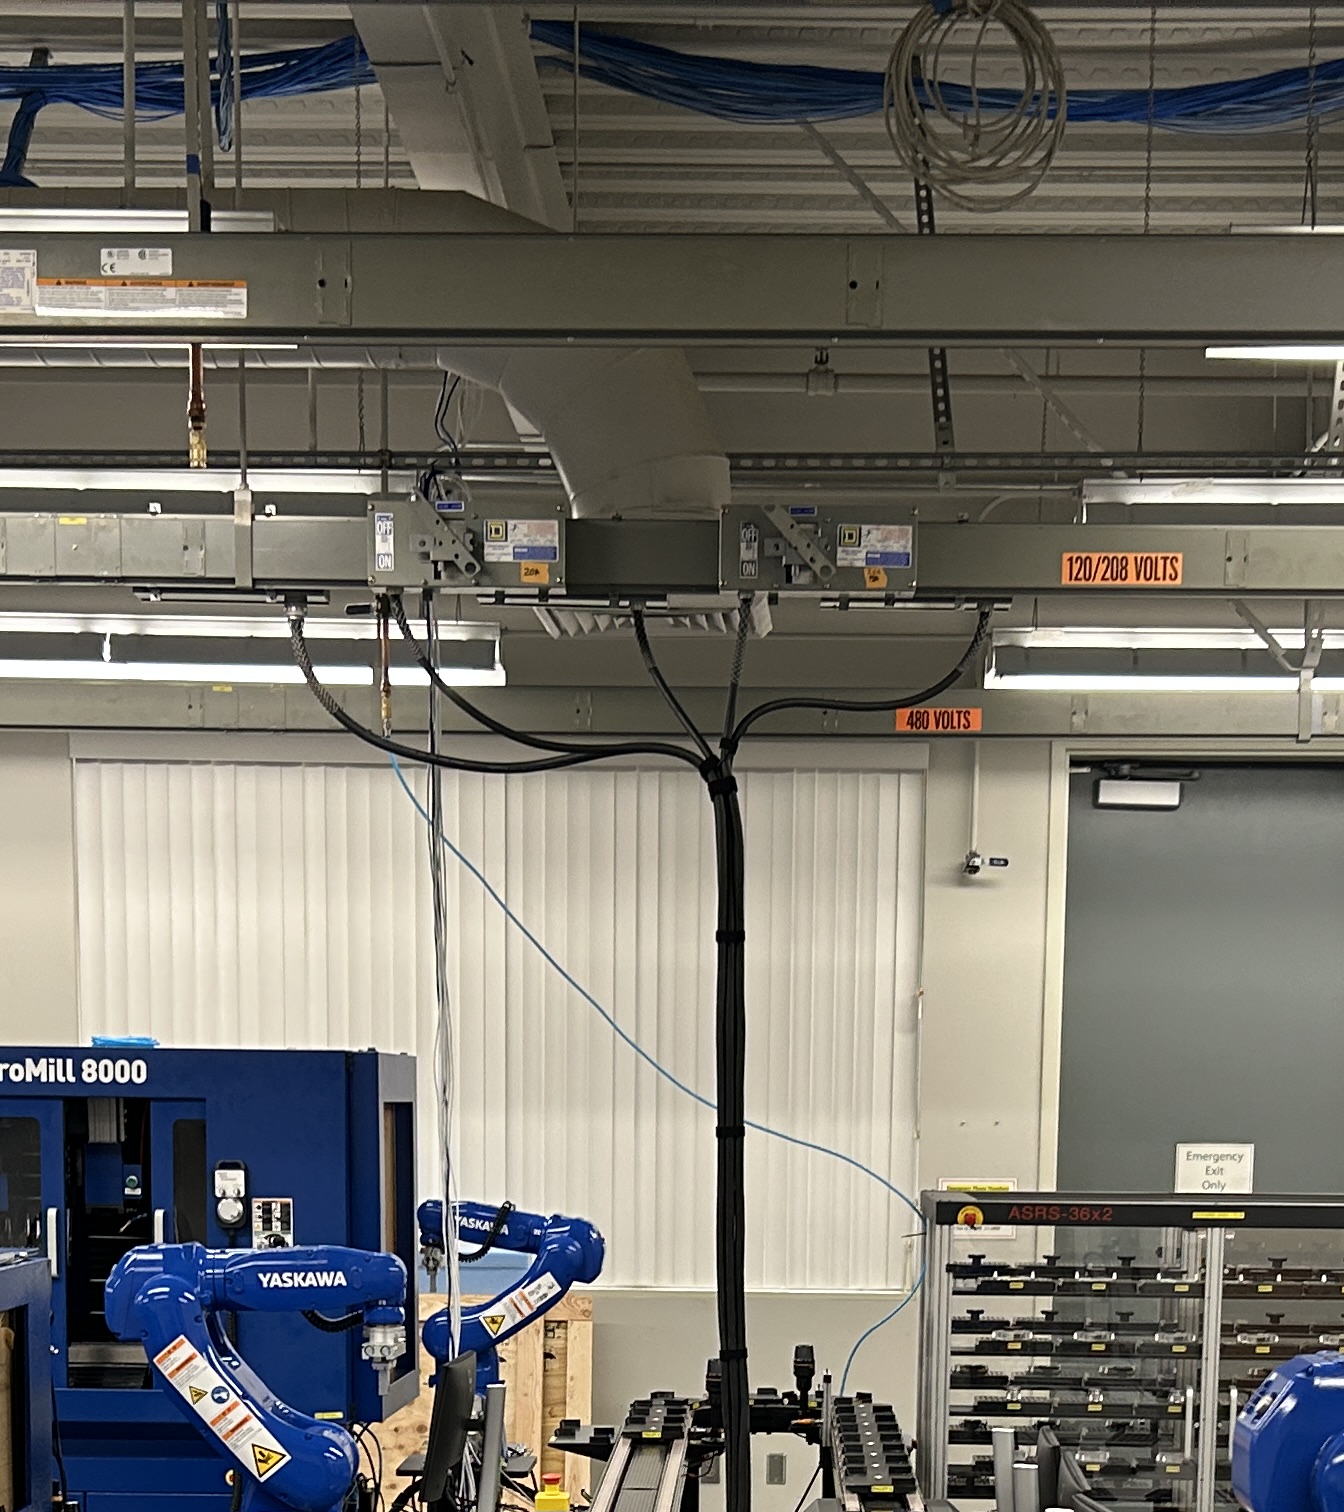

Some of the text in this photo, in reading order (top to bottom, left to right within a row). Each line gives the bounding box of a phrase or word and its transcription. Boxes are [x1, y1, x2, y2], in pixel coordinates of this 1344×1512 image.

[378, 555, 392, 570] ON
[742, 561, 755, 576] ON
[1067, 556, 1178, 582] 120/208 VOLTS
[906, 710, 971, 730] 480 VOLTS
[81, 1059, 147, 1084] 8000
[1186, 1151, 1244, 1163] Emergency
[1205, 1165, 1224, 1176] Exit
[1202, 1180, 1226, 1192] Only
[1008, 1204, 1114, 1222] ASRS-36x2
[454, 1215, 509, 1236] YASKAA
[258, 1270, 348, 1289] YASKAWA
